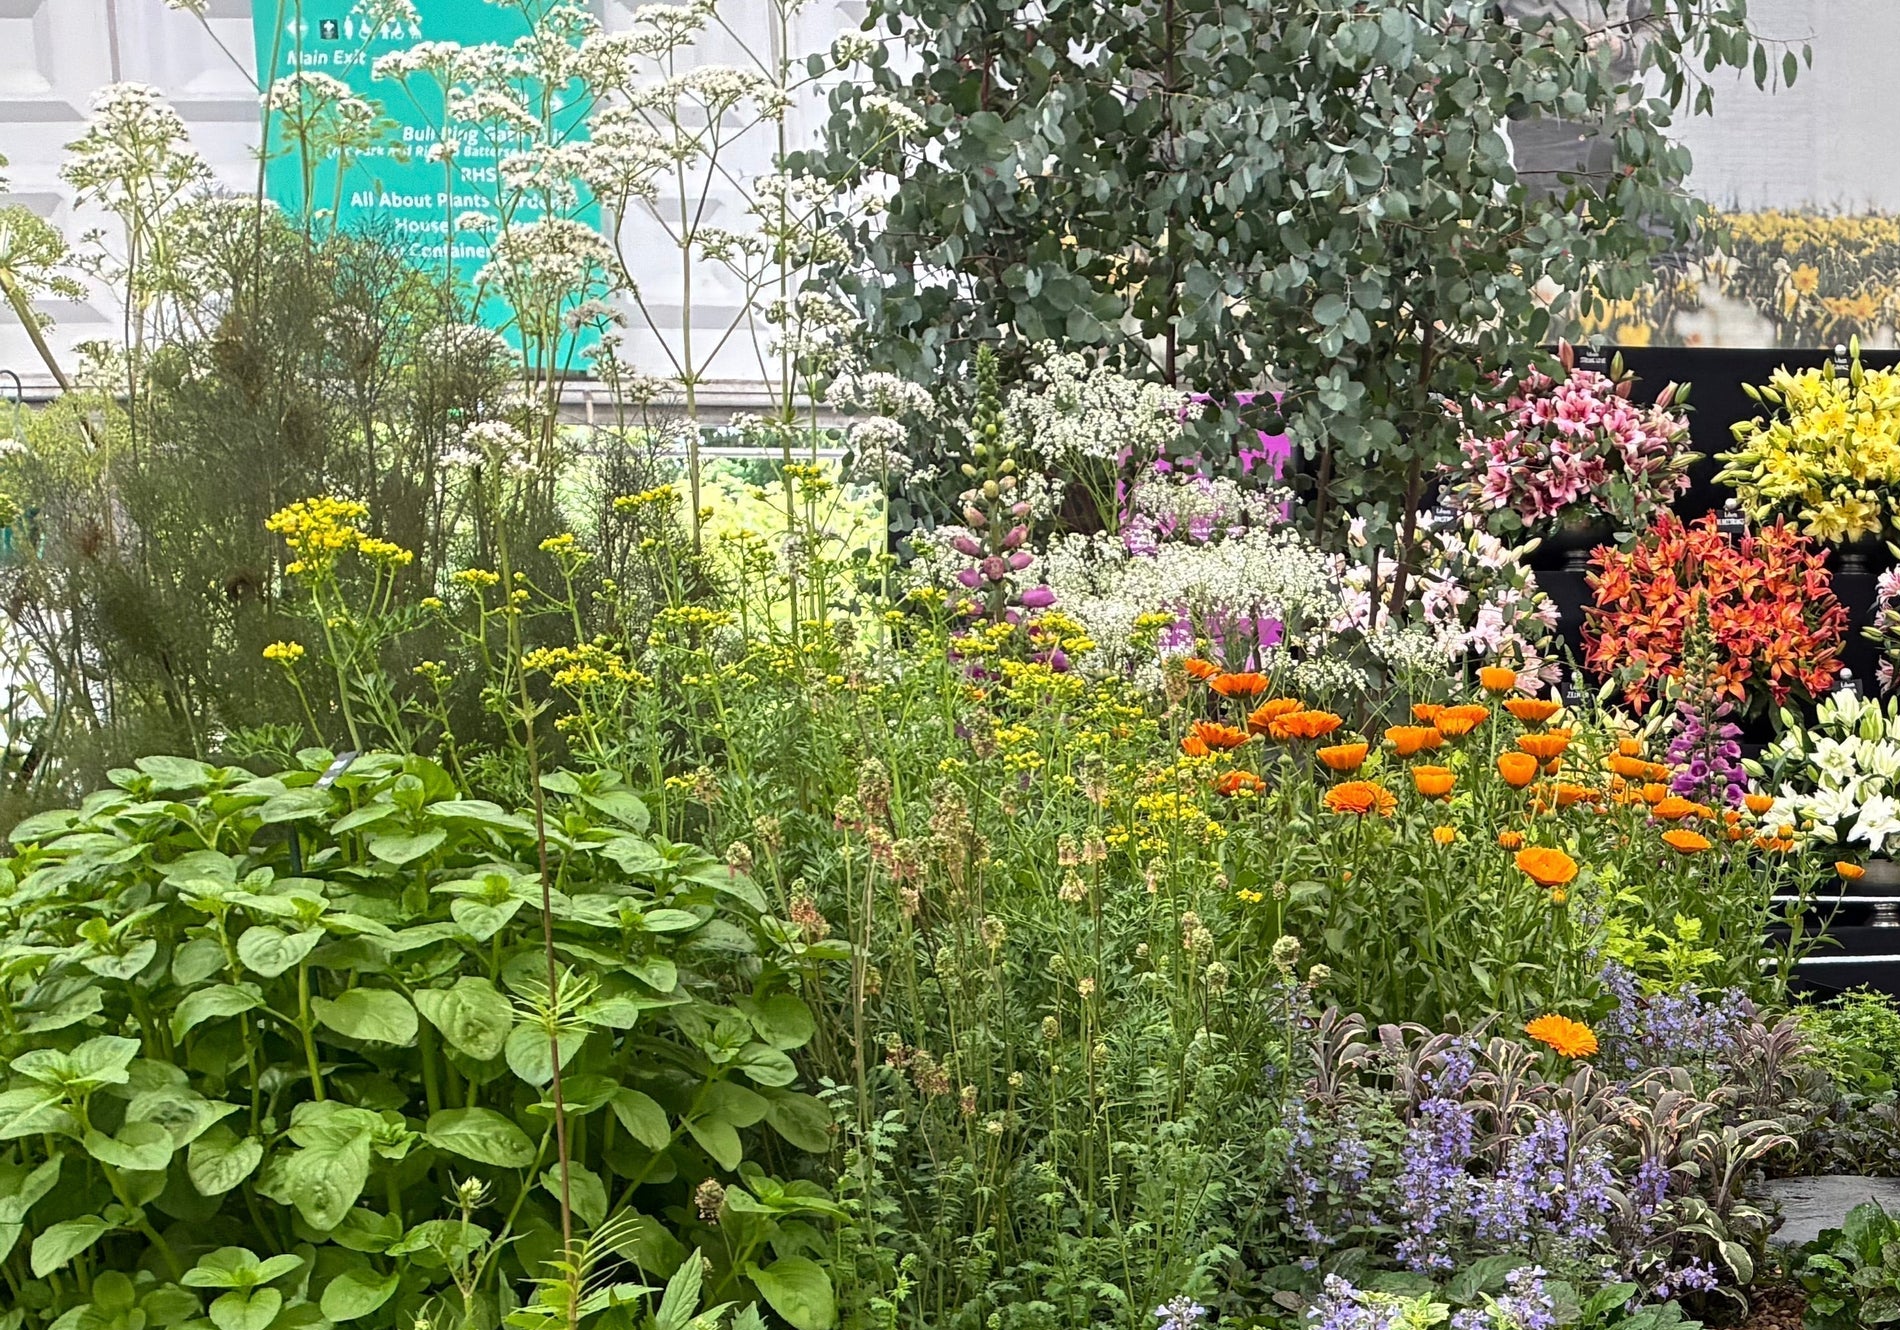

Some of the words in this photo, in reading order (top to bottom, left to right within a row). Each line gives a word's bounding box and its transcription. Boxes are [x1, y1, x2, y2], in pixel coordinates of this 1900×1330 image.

[333, 50, 366, 66] Exit
[461, 167, 497, 183] RHS
[351, 191, 374, 208] All
[379, 191, 433, 209] About
[437, 192, 490, 209] Plants
